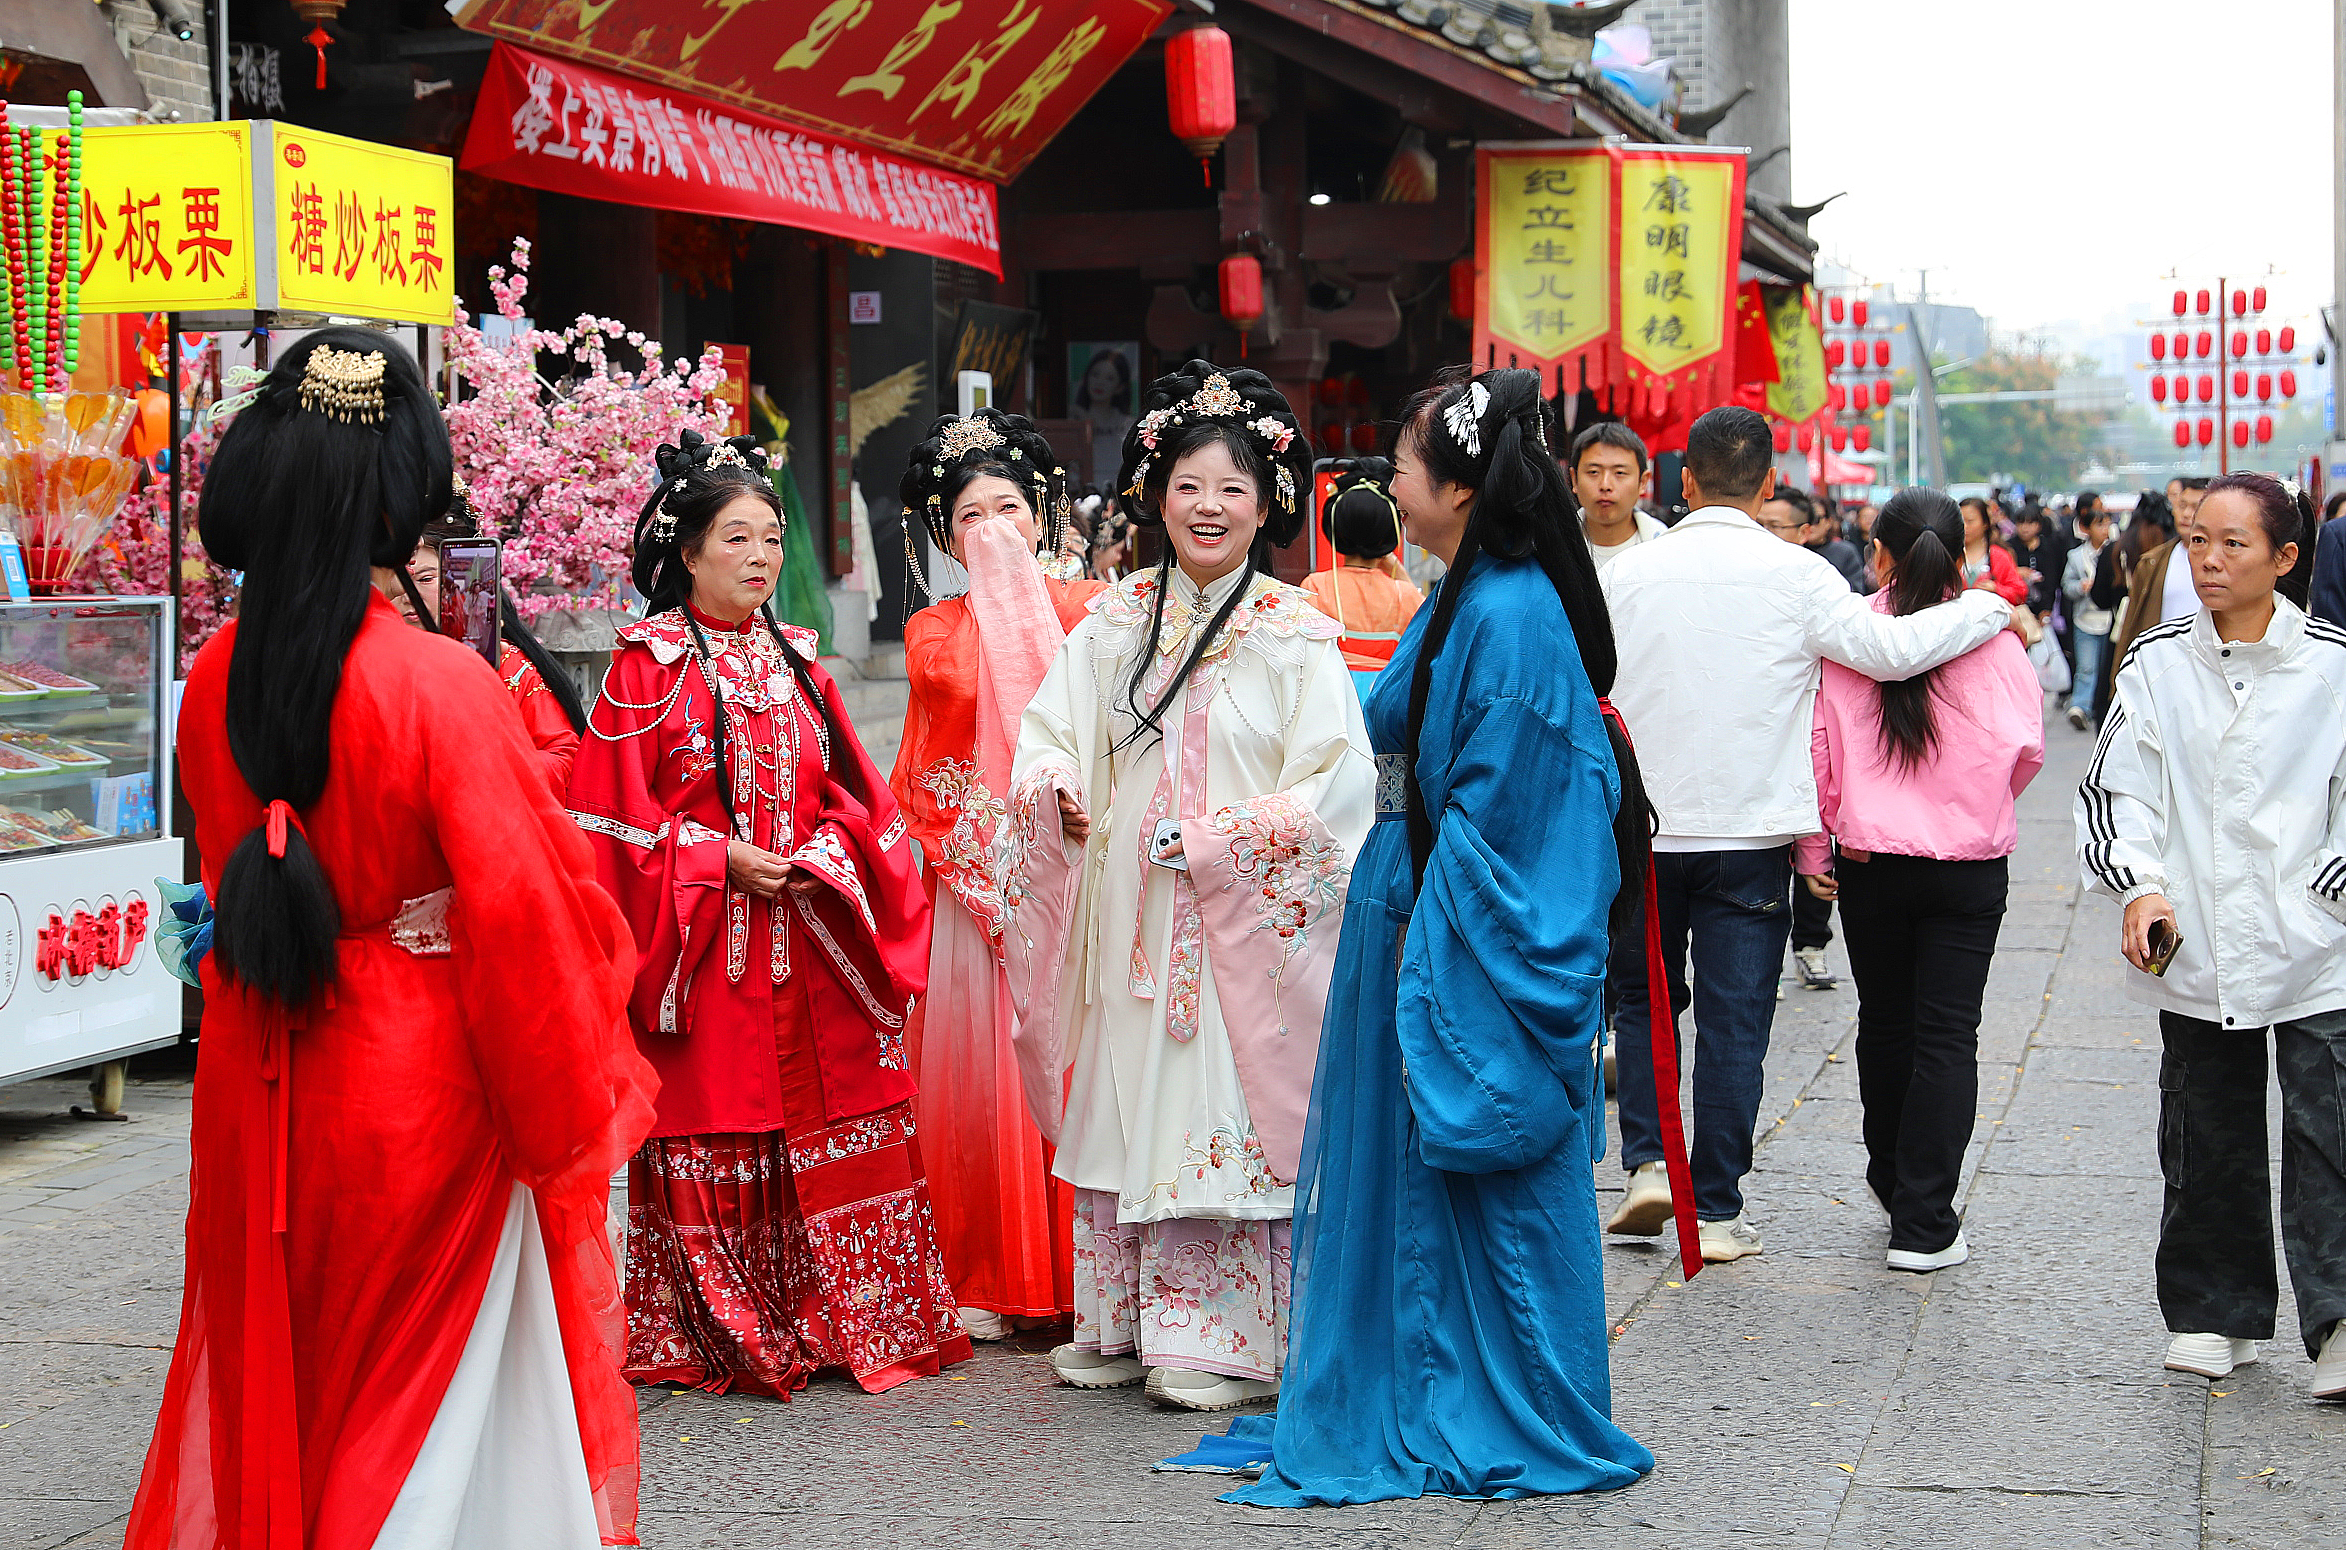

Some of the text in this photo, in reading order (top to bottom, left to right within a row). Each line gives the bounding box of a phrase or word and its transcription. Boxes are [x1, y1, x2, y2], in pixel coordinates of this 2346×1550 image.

[289, 180, 443, 293] 糖炒板栗
[1522, 168, 1575, 336] 纪立生儿科
[1638, 175, 1693, 351] 康明眼镜
